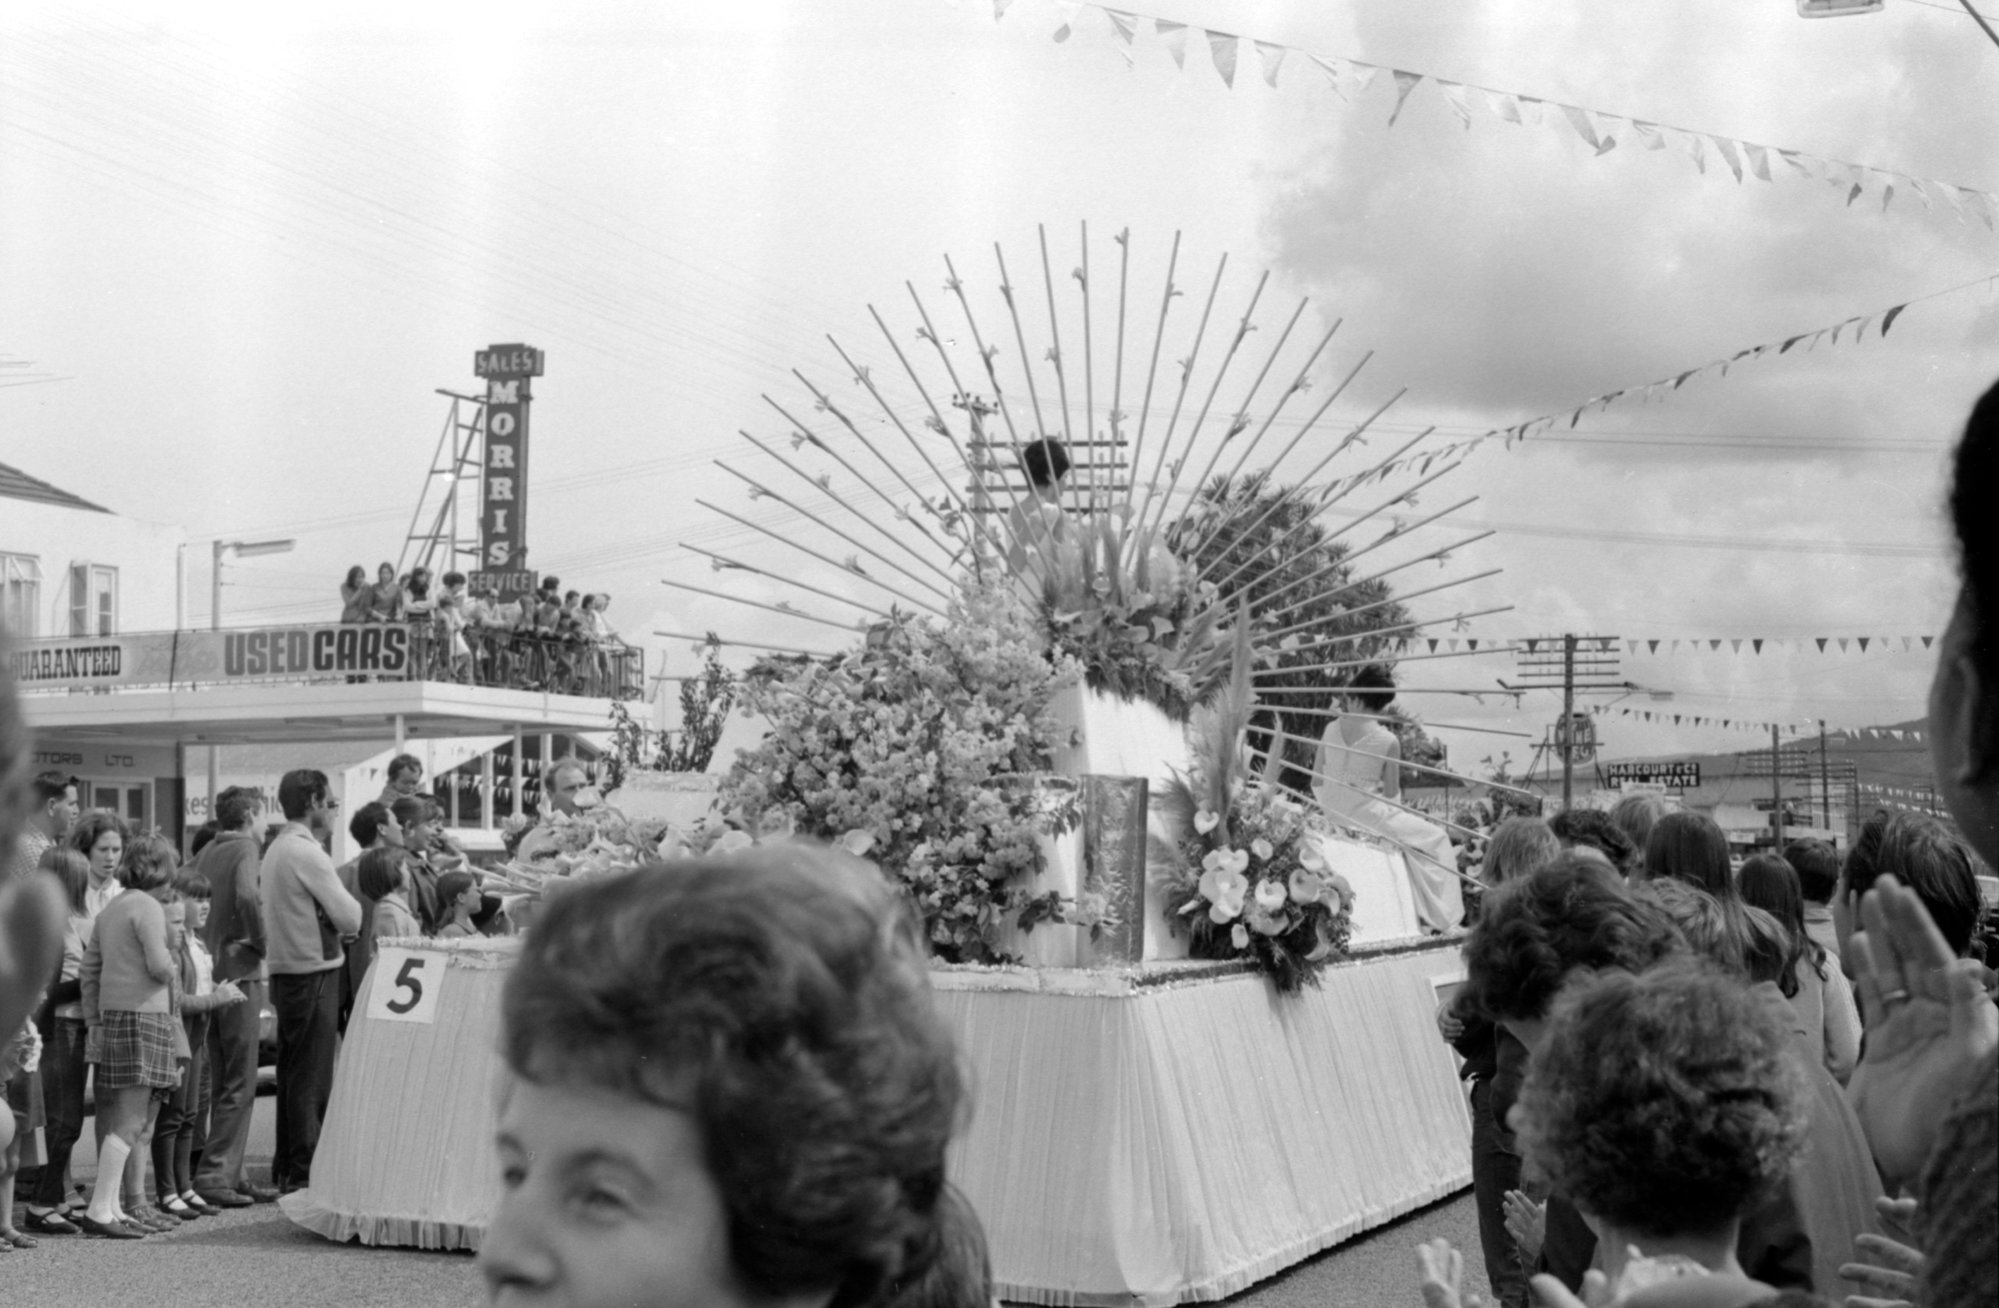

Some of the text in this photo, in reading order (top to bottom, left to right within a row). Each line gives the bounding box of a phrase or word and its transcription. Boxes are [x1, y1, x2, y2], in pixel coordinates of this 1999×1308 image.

[477, 351, 533, 373] SALES
[487, 380, 520, 566] MORRIS
[468, 572, 530, 592] SERVICE
[224, 630, 309, 676] USED
[313, 628, 407, 671] CARS
[386, 957, 426, 1015] 5
